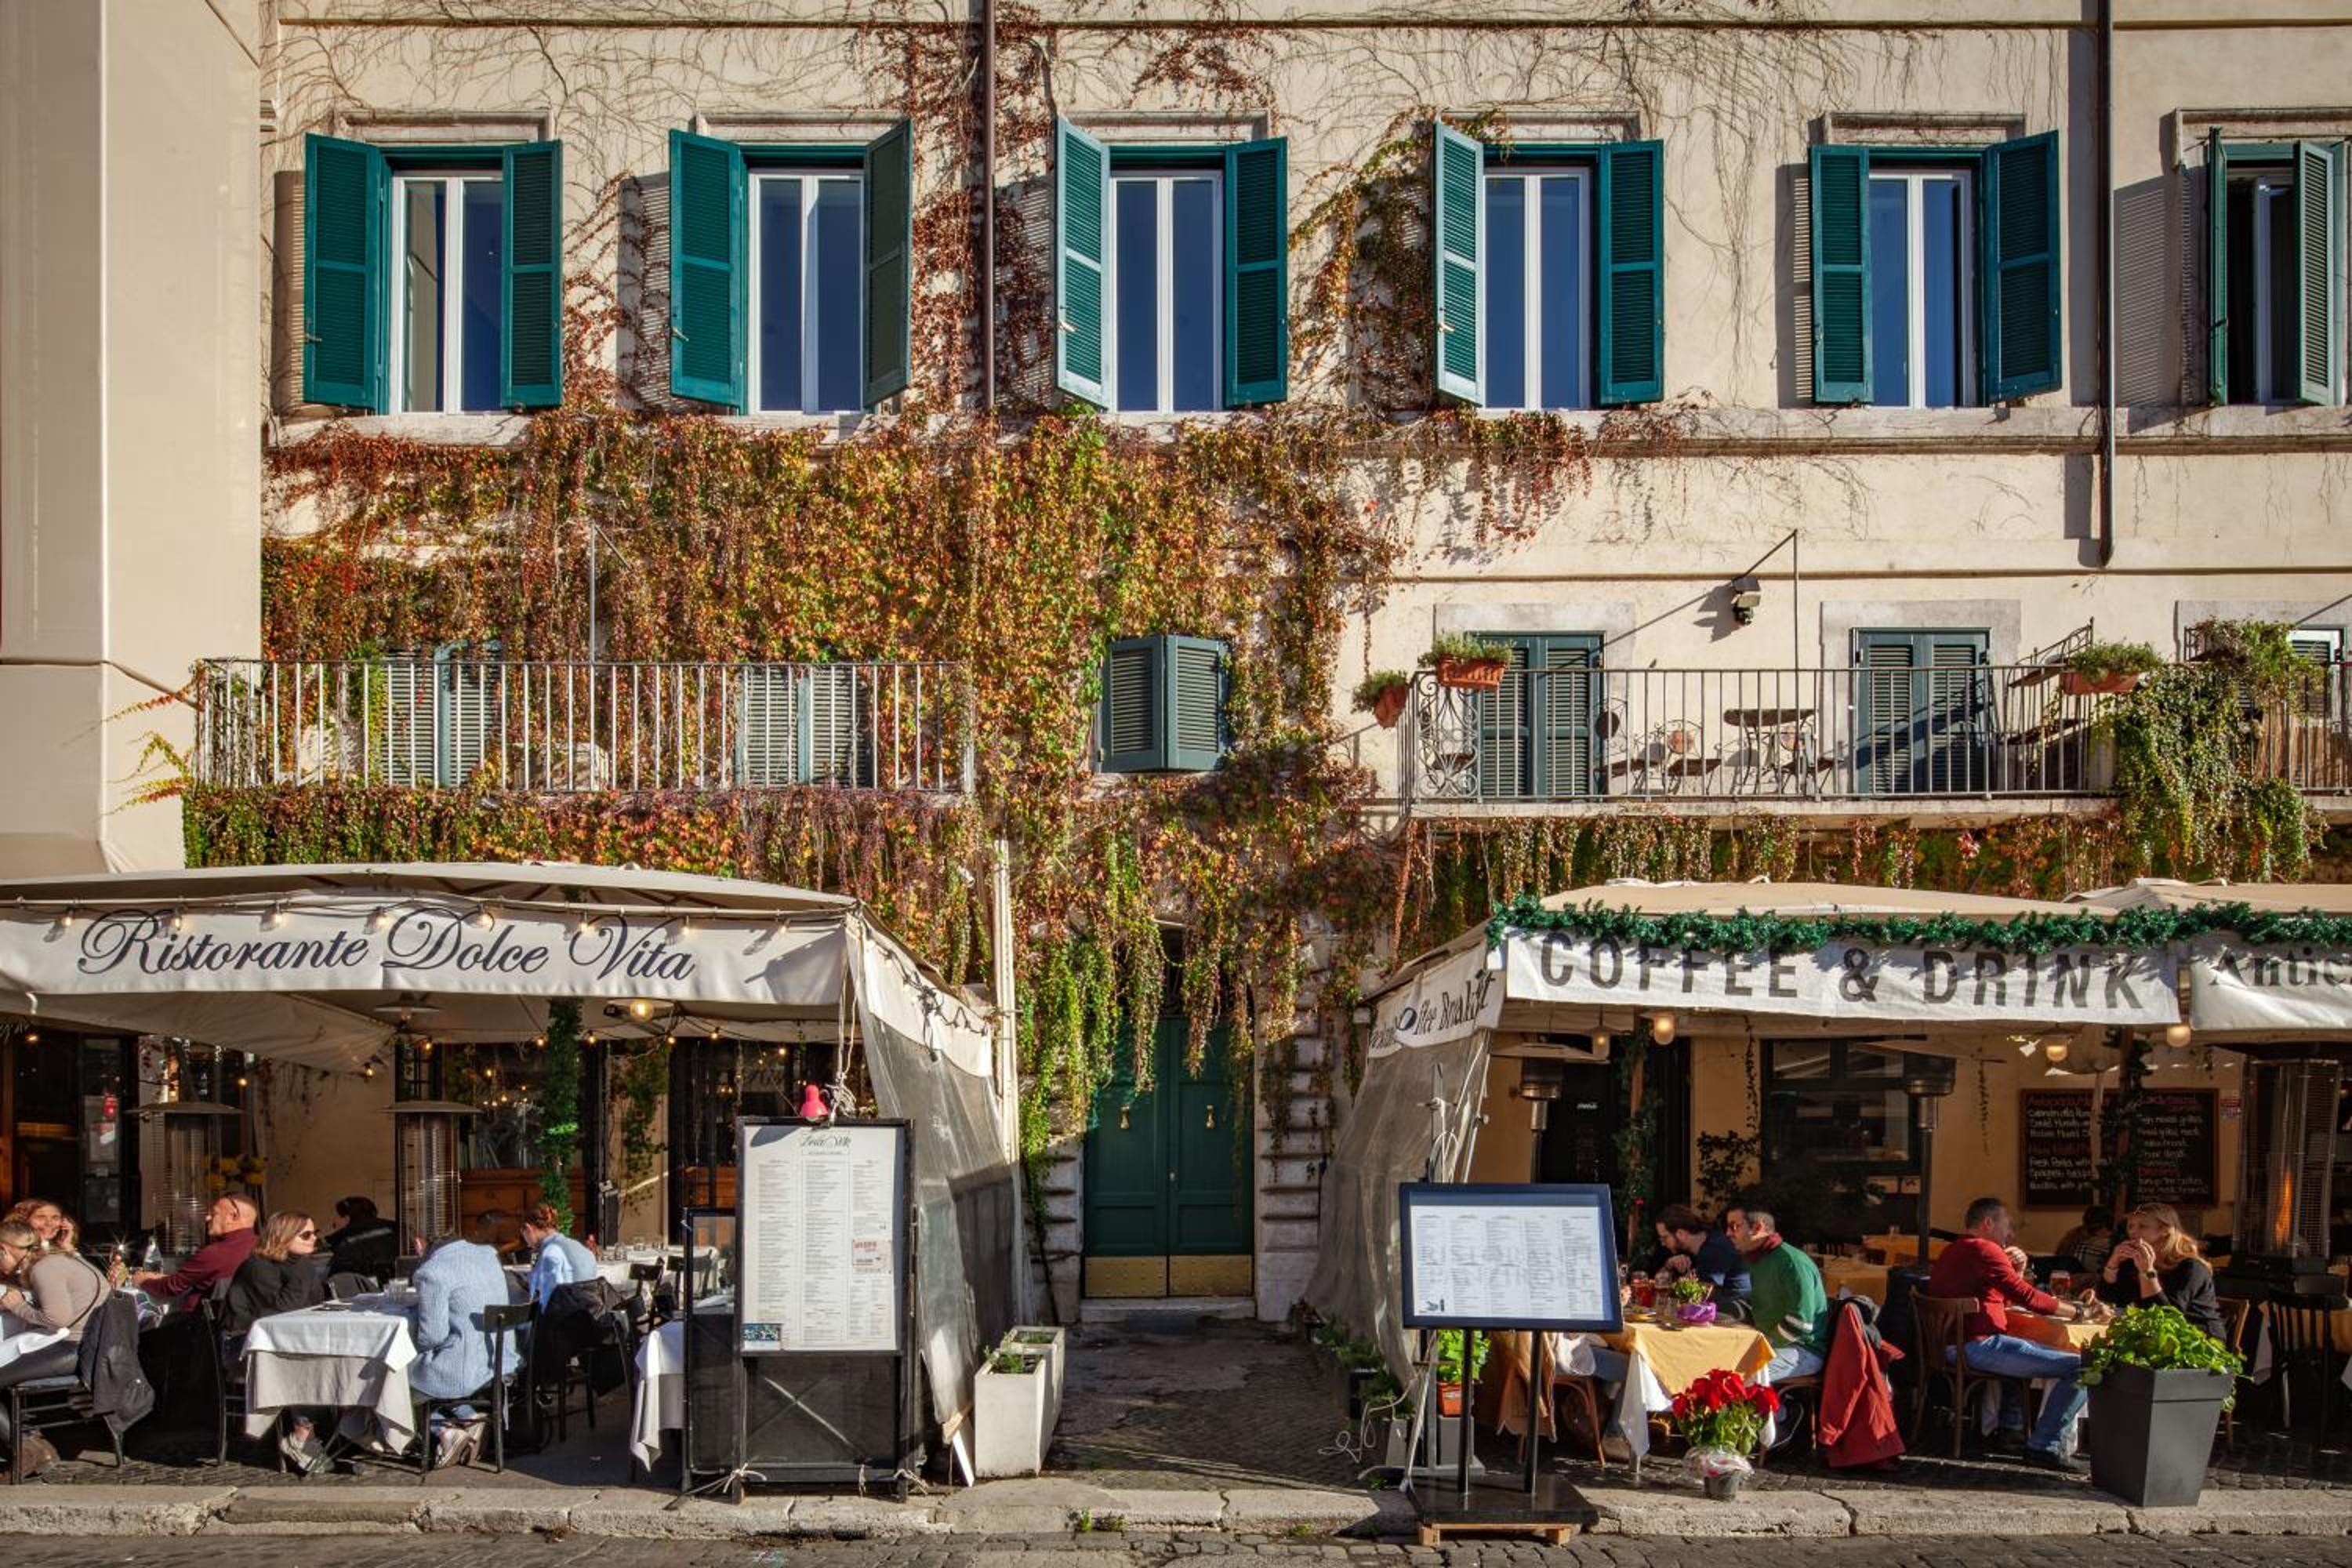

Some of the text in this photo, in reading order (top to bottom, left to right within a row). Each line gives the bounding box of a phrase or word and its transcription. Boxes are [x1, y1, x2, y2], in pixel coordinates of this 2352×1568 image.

[78, 907, 696, 981] Ristorante Dolce Vita
[1541, 931, 2143, 1009] COFFEE & DRINK
[2209, 946, 2352, 988] Antic
